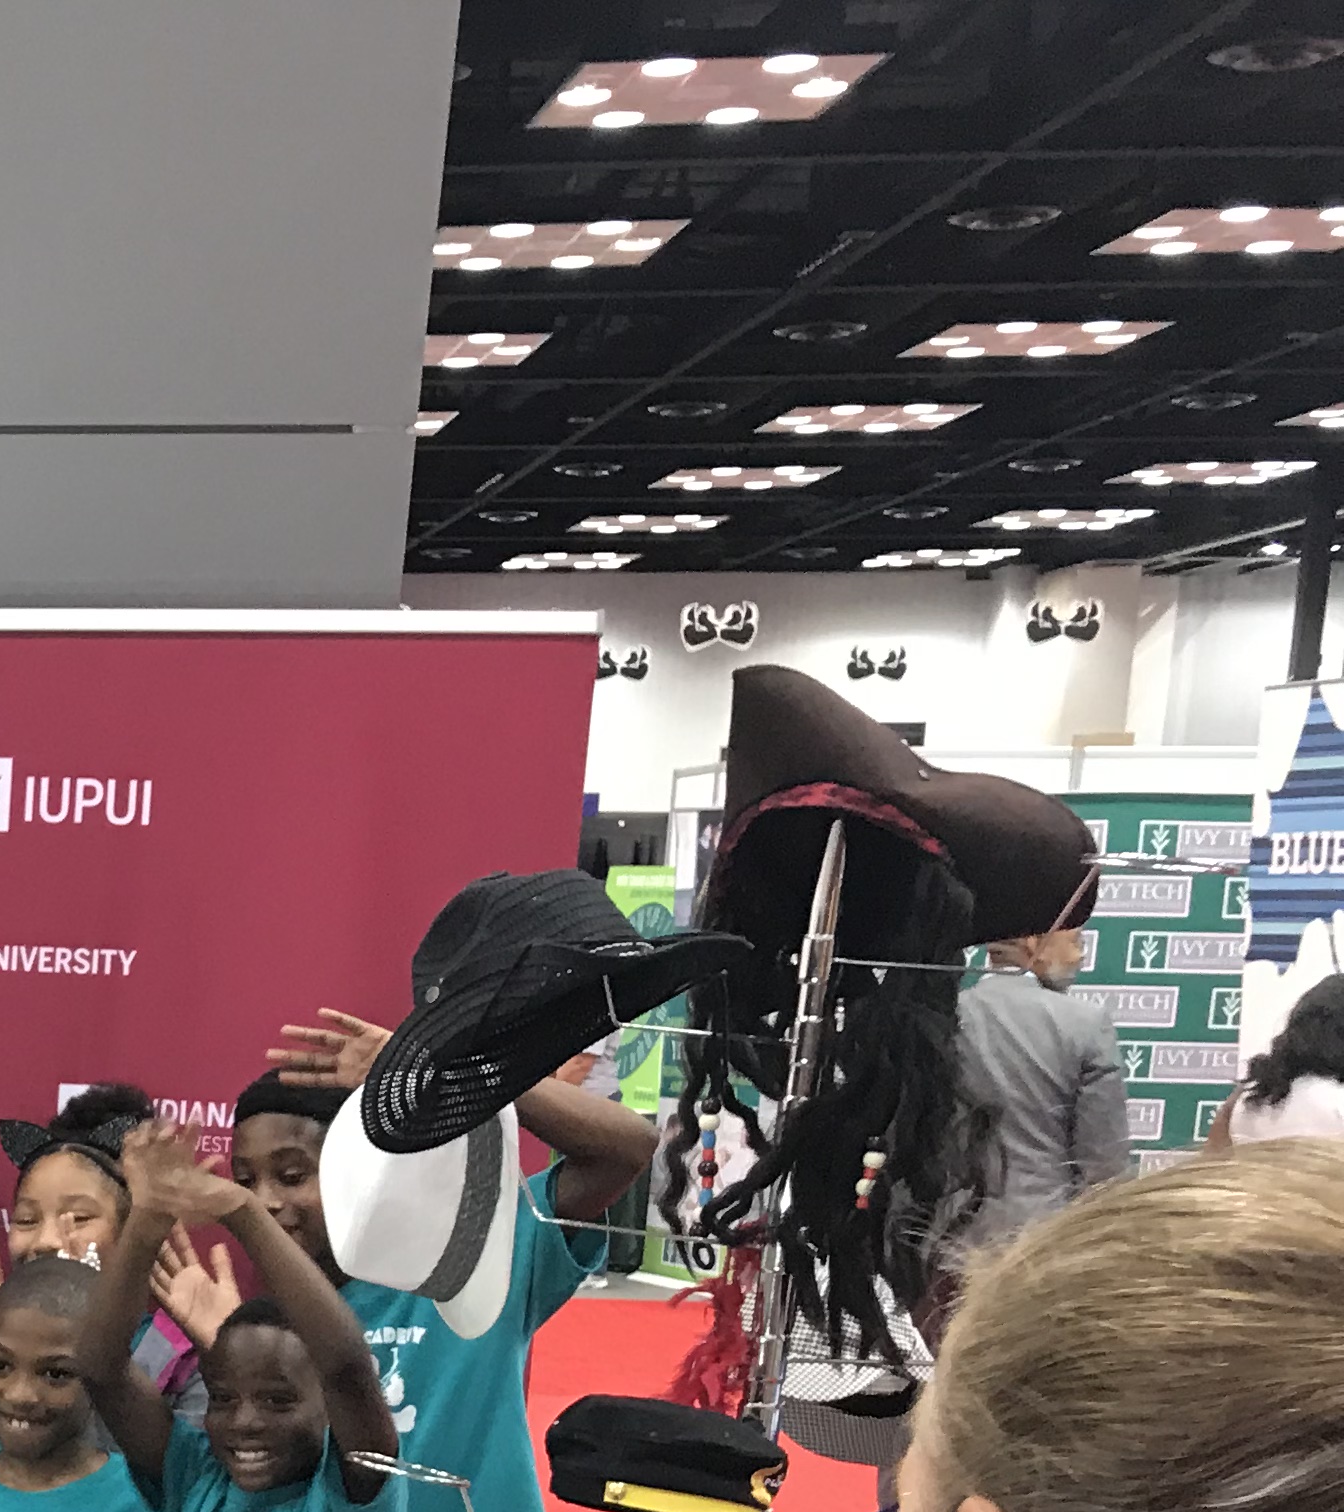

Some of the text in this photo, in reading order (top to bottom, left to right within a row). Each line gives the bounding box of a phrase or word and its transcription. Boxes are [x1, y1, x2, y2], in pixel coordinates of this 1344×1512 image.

[23, 775, 153, 826] IUPUI
[1183, 827, 1252, 847] IVY TE
[1097, 881, 1184, 901] VY TECH
[1172, 940, 1212, 957] IVY
[1115, 992, 1171, 1011] TECH
[1156, 1049, 1239, 1068] IVY TEC
